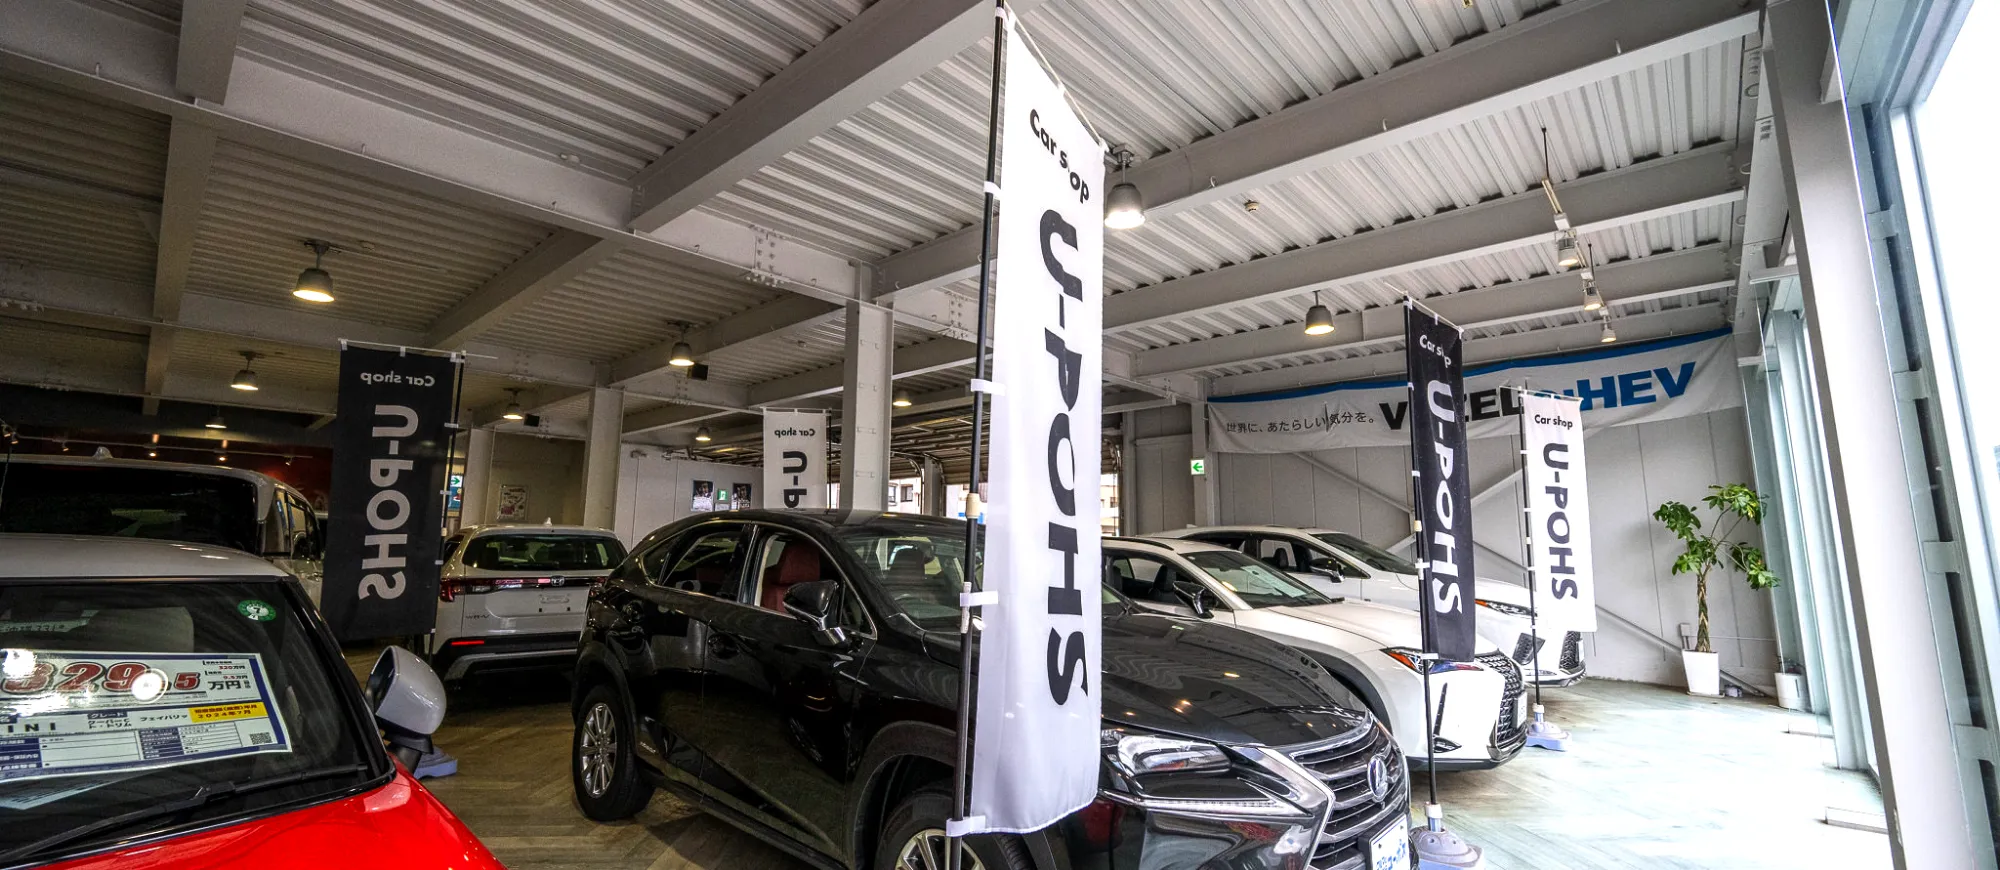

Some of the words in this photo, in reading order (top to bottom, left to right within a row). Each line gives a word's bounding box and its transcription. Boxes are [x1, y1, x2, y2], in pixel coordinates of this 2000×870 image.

[1029, 109, 1057, 155] Car
[1060, 150, 1090, 204] sop
[1420, 334, 1436, 353] Car
[1436, 345, 1452, 368] sp
[1226, 411, 1375, 433] 世界に、あたらしい気分を。
[1379, 386, 1524, 430] VEL
[1534, 414, 1551, 425] Car
[1040, 209, 1088, 705] U-POHS
[1427, 380, 1463, 614] U-POHS
[1543, 442, 1578, 600] U-POHS
[208, 680, 241, 690] 万円
[7, 722, 56, 733] INI
